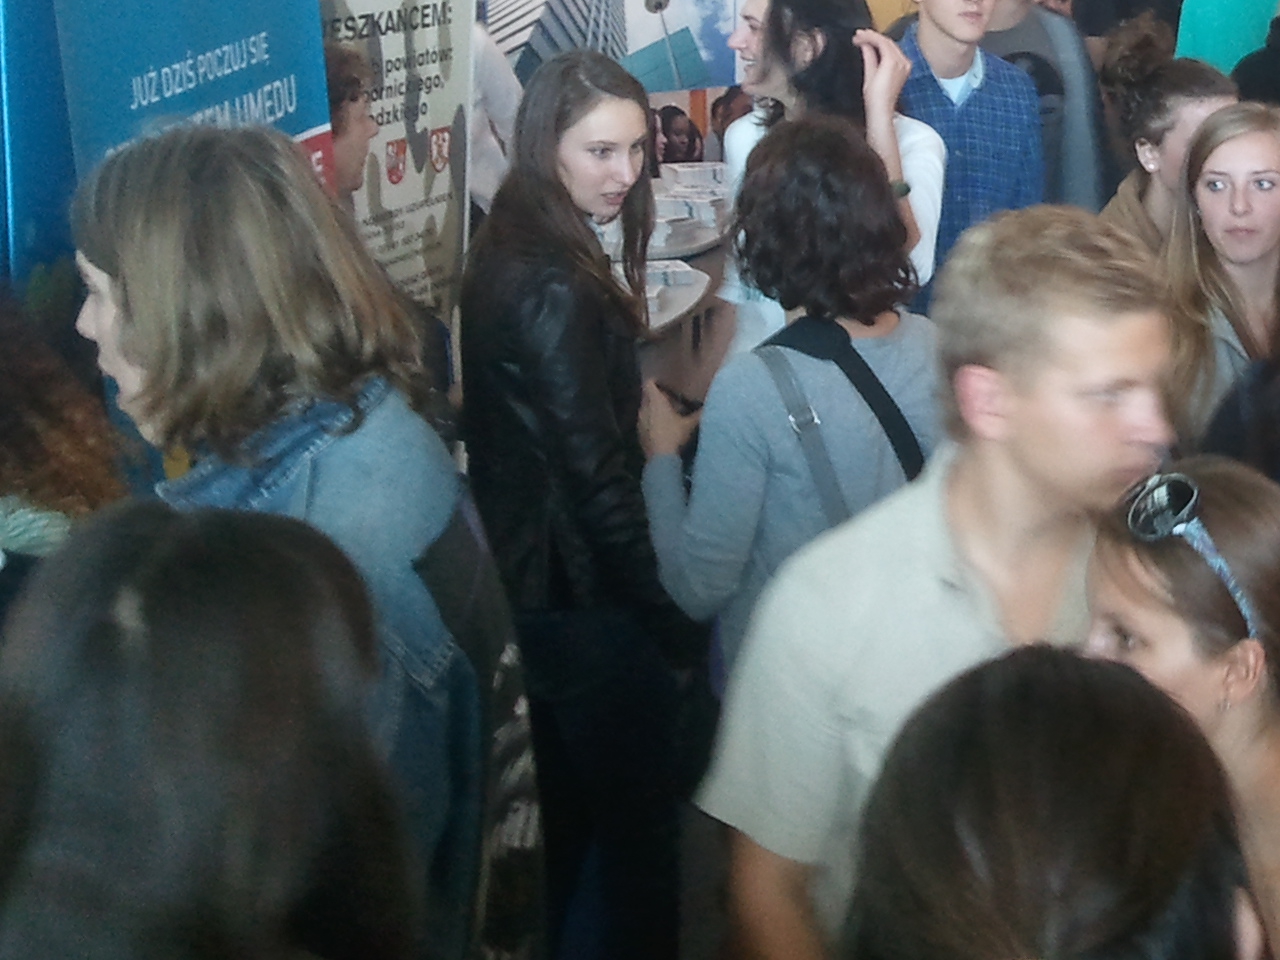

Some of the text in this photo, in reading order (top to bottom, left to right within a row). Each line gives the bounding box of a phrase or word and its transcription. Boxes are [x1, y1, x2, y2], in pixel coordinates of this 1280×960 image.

[130, 31, 270, 110] JUŻ DZIŚ POCZUJ SIĘ
[235, 73, 297, 128] UMEDU
